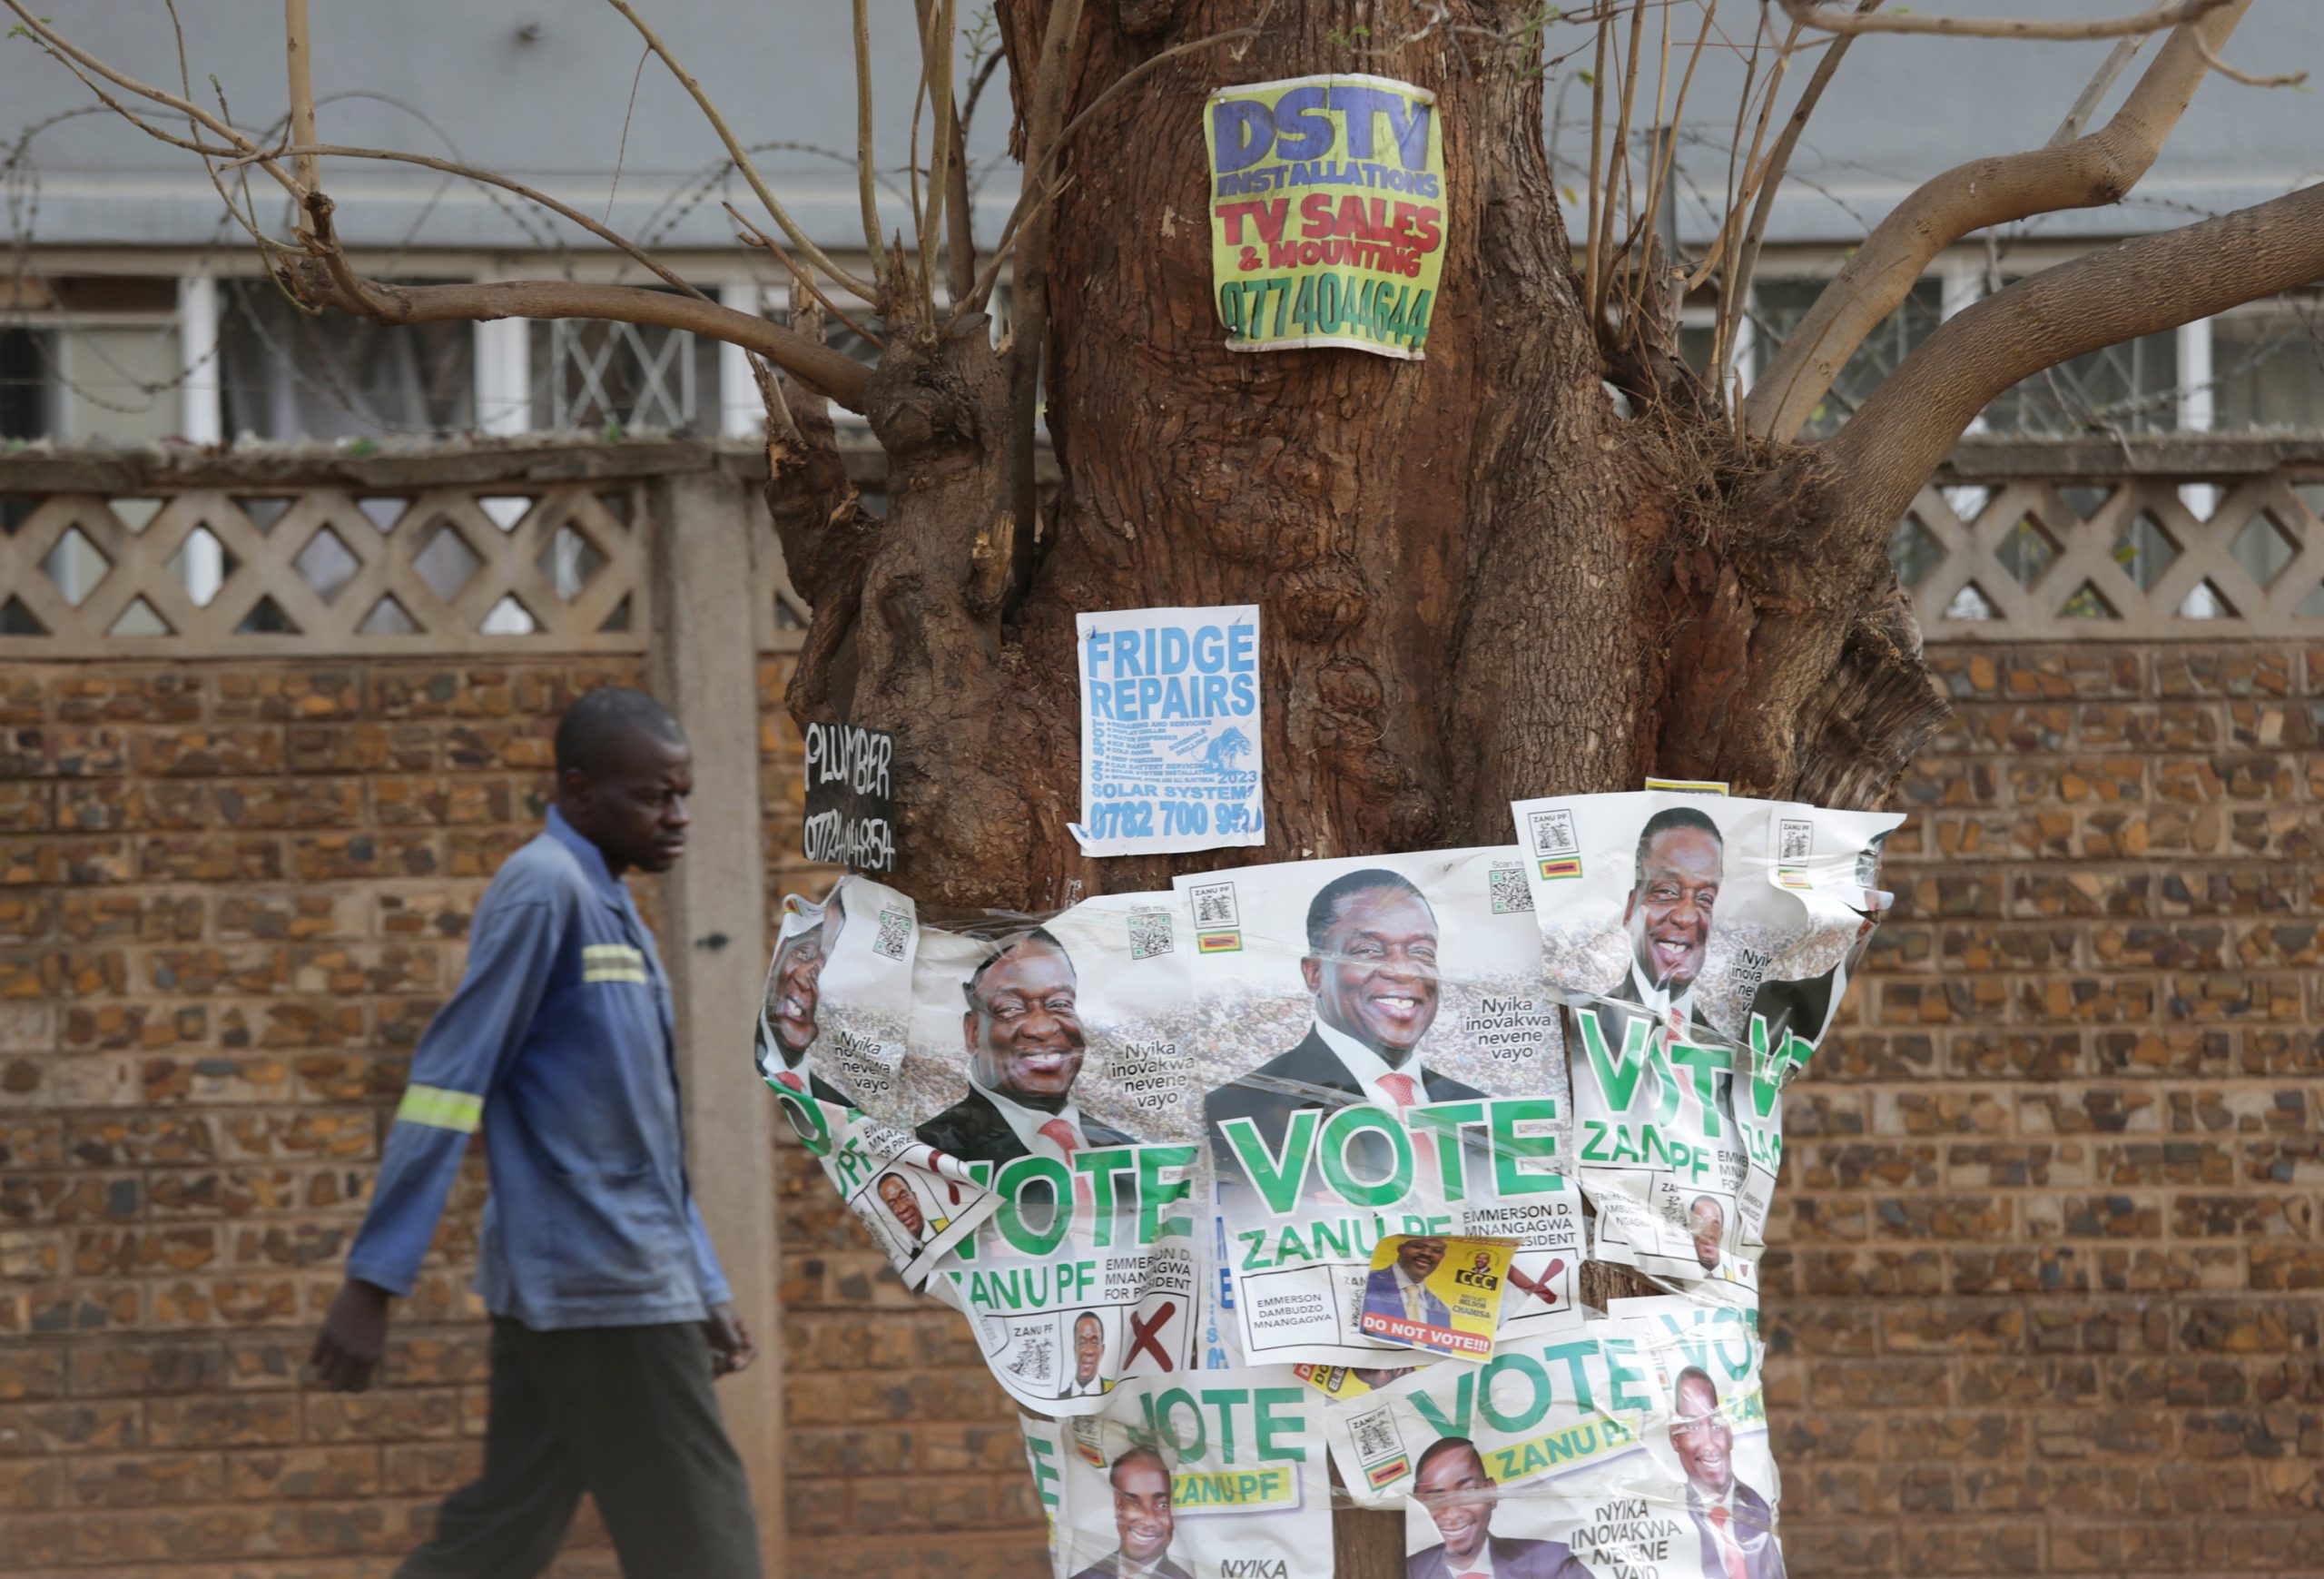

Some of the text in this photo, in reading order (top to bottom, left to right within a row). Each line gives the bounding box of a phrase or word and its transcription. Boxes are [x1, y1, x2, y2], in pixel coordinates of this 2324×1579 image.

[1213, 86, 1432, 173] DSTV
[1217, 161, 1439, 199] INSTALLATIONS
[1215, 193, 1442, 252] TV SALES
[1238, 240, 1422, 278] & MOUNTING
[1221, 272, 1433, 348] 0774044644
[1088, 625, 1255, 678] FRIDGE
[1090, 674, 1255, 721] REPAIRS
[1092, 719, 1104, 756] SPOT
[804, 723, 891, 800] PLUMBER
[1218, 770, 1257, 784] 2023
[1092, 784, 1158, 799] SOLAR
[1090, 801, 1154, 840] 0782
[1160, 801, 1208, 835] 700
[1532, 814, 1556, 823] ZANU
[1492, 861, 1512, 869] Scan
[1195, 888, 1217, 896] ZANU
[1482, 996, 1532, 1017] Nyika
[1466, 1012, 1551, 1031] inovakwa
[841, 1031, 881, 1054] Nyika
[1478, 1031, 1542, 1045] nevene
[1126, 1041, 1176, 1062] Nyika
[1492, 1047, 1533, 1062] vayo
[1111, 1056, 1195, 1078] inovakwa
[854, 1078, 890, 1093] vayo
[1125, 1075, 1187, 1092] nevene
[1137, 1092, 1177, 1110] vayo
[1220, 1100, 1565, 1214] VOTE
[1670, 1141, 1710, 1184] PF
[1462, 1203, 1572, 1224] EMMERSON D.
[1464, 1218, 1573, 1237] MNANGAGWA
[1180, 1249, 1193, 1262] D.
[1057, 1260, 1096, 1304] PF
[1460, 1271, 1494, 1289] CCC
[1105, 1288, 1129, 1299] FOR
[1256, 1294, 1322, 1308] EMMERSON
[1254, 1314, 1333, 1328] MNANGAGWA
[1258, 1304, 1324, 1318] DAMBUDZO
[1013, 1326, 1042, 1337] ZANU
[1364, 1317, 1490, 1352] DO NOT VOTE!!!
[1407, 1339, 1653, 1441] VOTE
[1496, 1426, 1597, 1479] ZANU
[1239, 1472, 1279, 1502] PF
[1595, 1499, 1649, 1522] NYIKA
[1571, 1519, 1683, 1549] INOVAKWA
[1592, 1540, 1669, 1564] NEVENE
[1221, 1559, 1288, 1579] NYIKA
